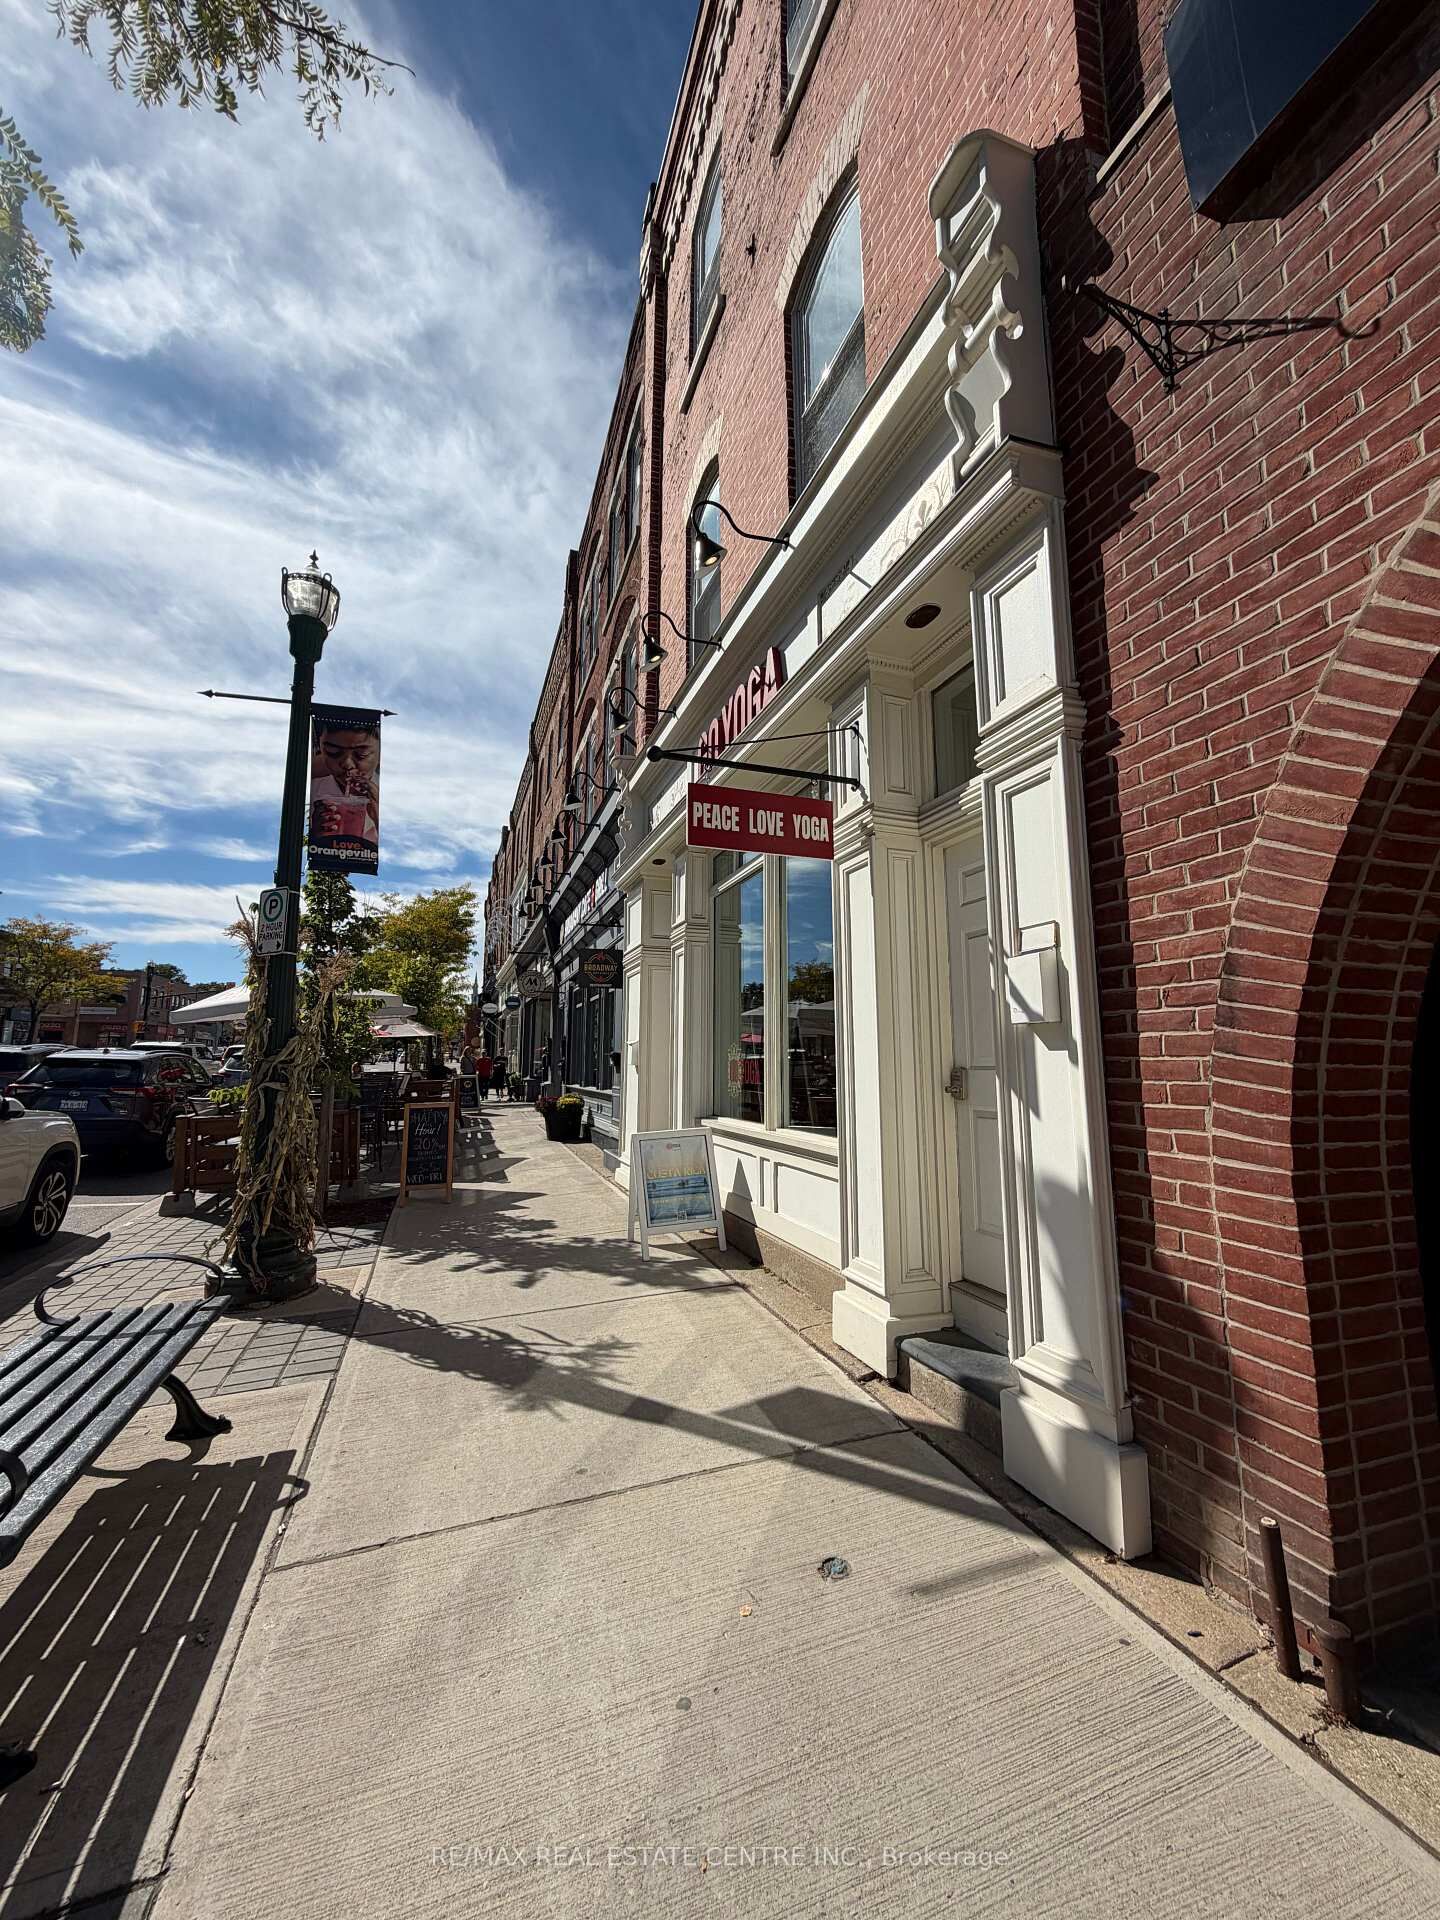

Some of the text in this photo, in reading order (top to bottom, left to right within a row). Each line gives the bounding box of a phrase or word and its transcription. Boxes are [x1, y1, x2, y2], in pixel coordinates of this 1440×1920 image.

[722, 647, 781, 744] YOGA
[693, 802, 830, 842] PEACE LOVE YOGA
[309, 845, 378, 860] Orangeville
[268, 898, 279, 915] P
[260, 922, 283, 932] 2 HOUR
[259, 931, 283, 942] PARKING
[583, 963, 618, 972] BROADWAY
[414, 1110, 448, 1124] HAPPY
